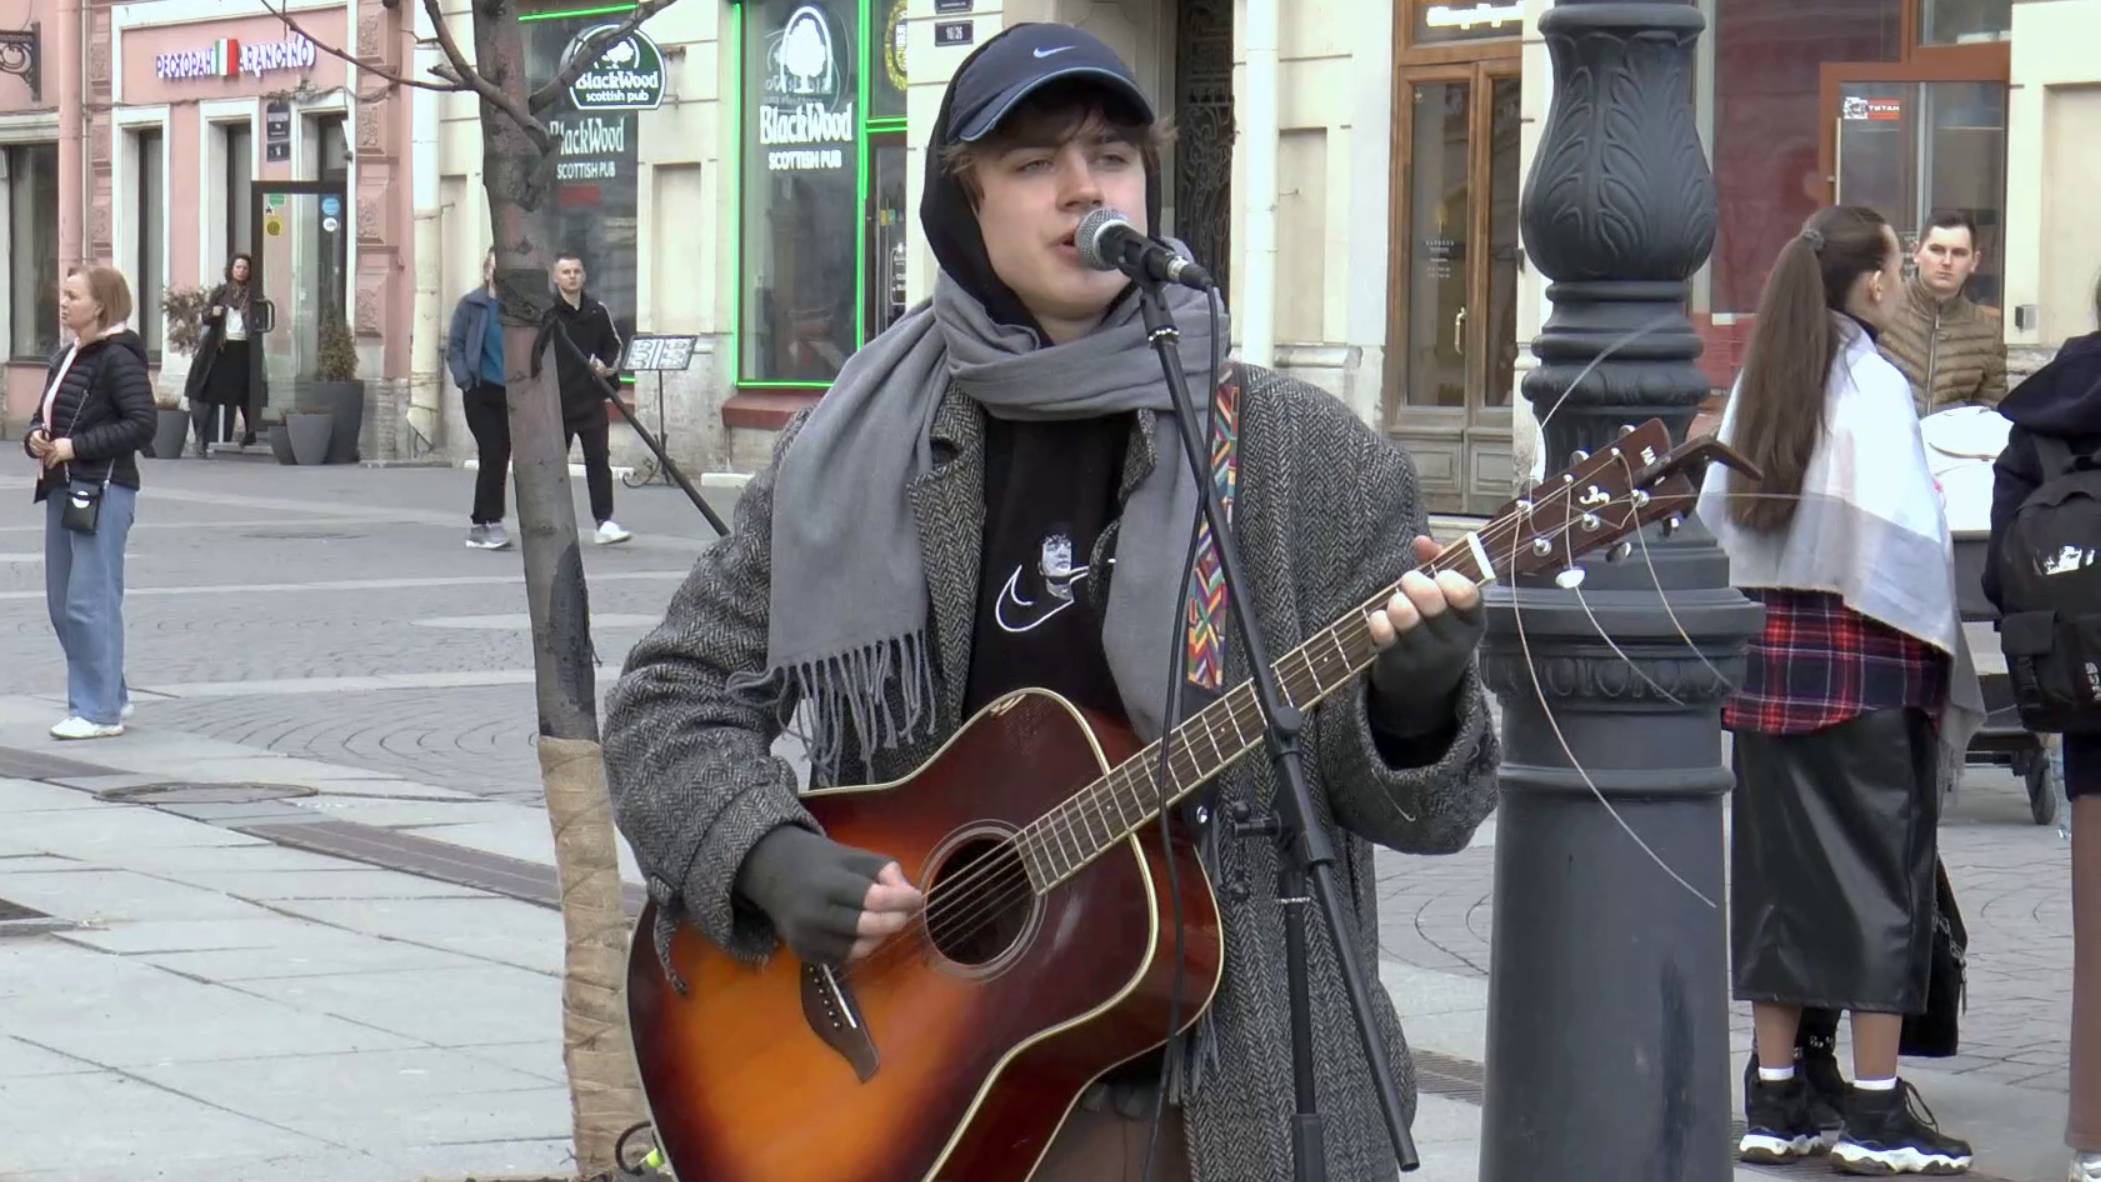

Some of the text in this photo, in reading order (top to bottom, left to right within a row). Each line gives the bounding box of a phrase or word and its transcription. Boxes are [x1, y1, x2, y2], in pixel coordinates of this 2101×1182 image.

[156, 48, 216, 78] РЕСТОРАН
[586, 90, 649, 103] scottish pub
[760, 102, 852, 144] BlackWood
[557, 161, 616, 179] SCOTTISH PUB
[768, 149, 842, 170] SCOTTISH PUB
